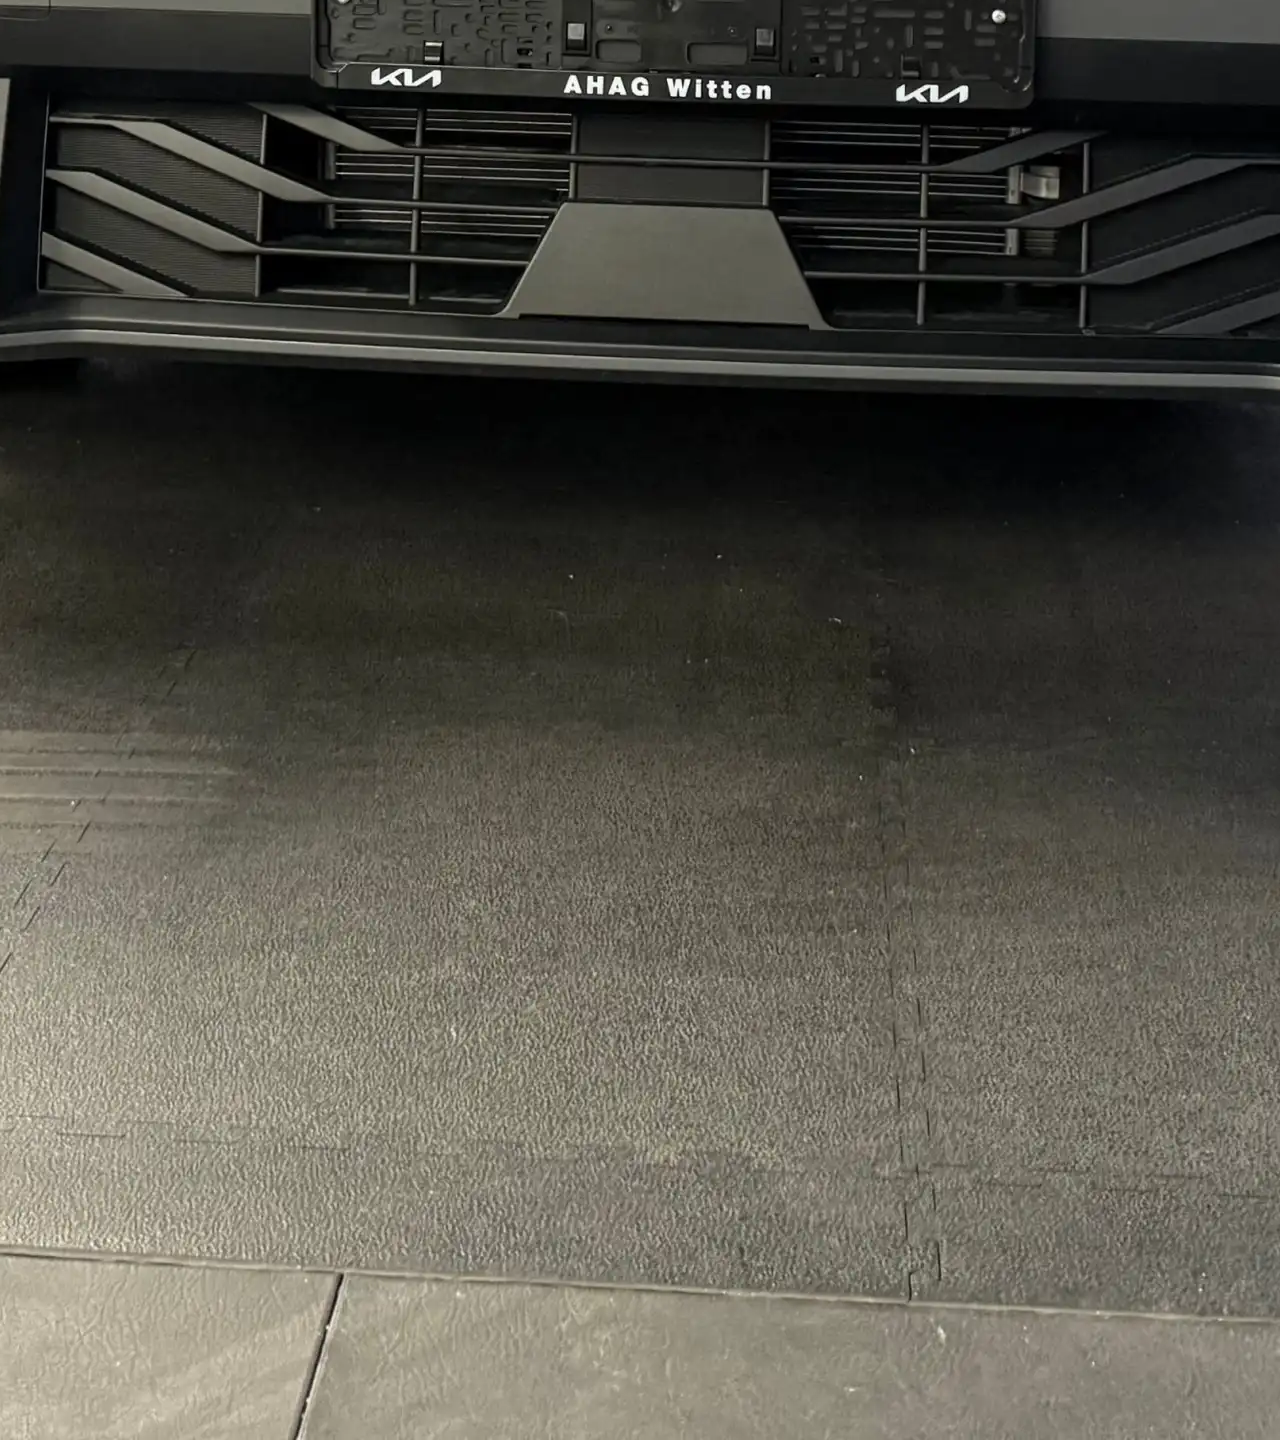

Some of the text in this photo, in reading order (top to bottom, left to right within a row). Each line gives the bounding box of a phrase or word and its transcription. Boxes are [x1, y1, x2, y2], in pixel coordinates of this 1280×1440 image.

[371, 66, 442, 88] KIA
[563, 73, 773, 101] AHAG Witten
[895, 83, 970, 105] KIA
